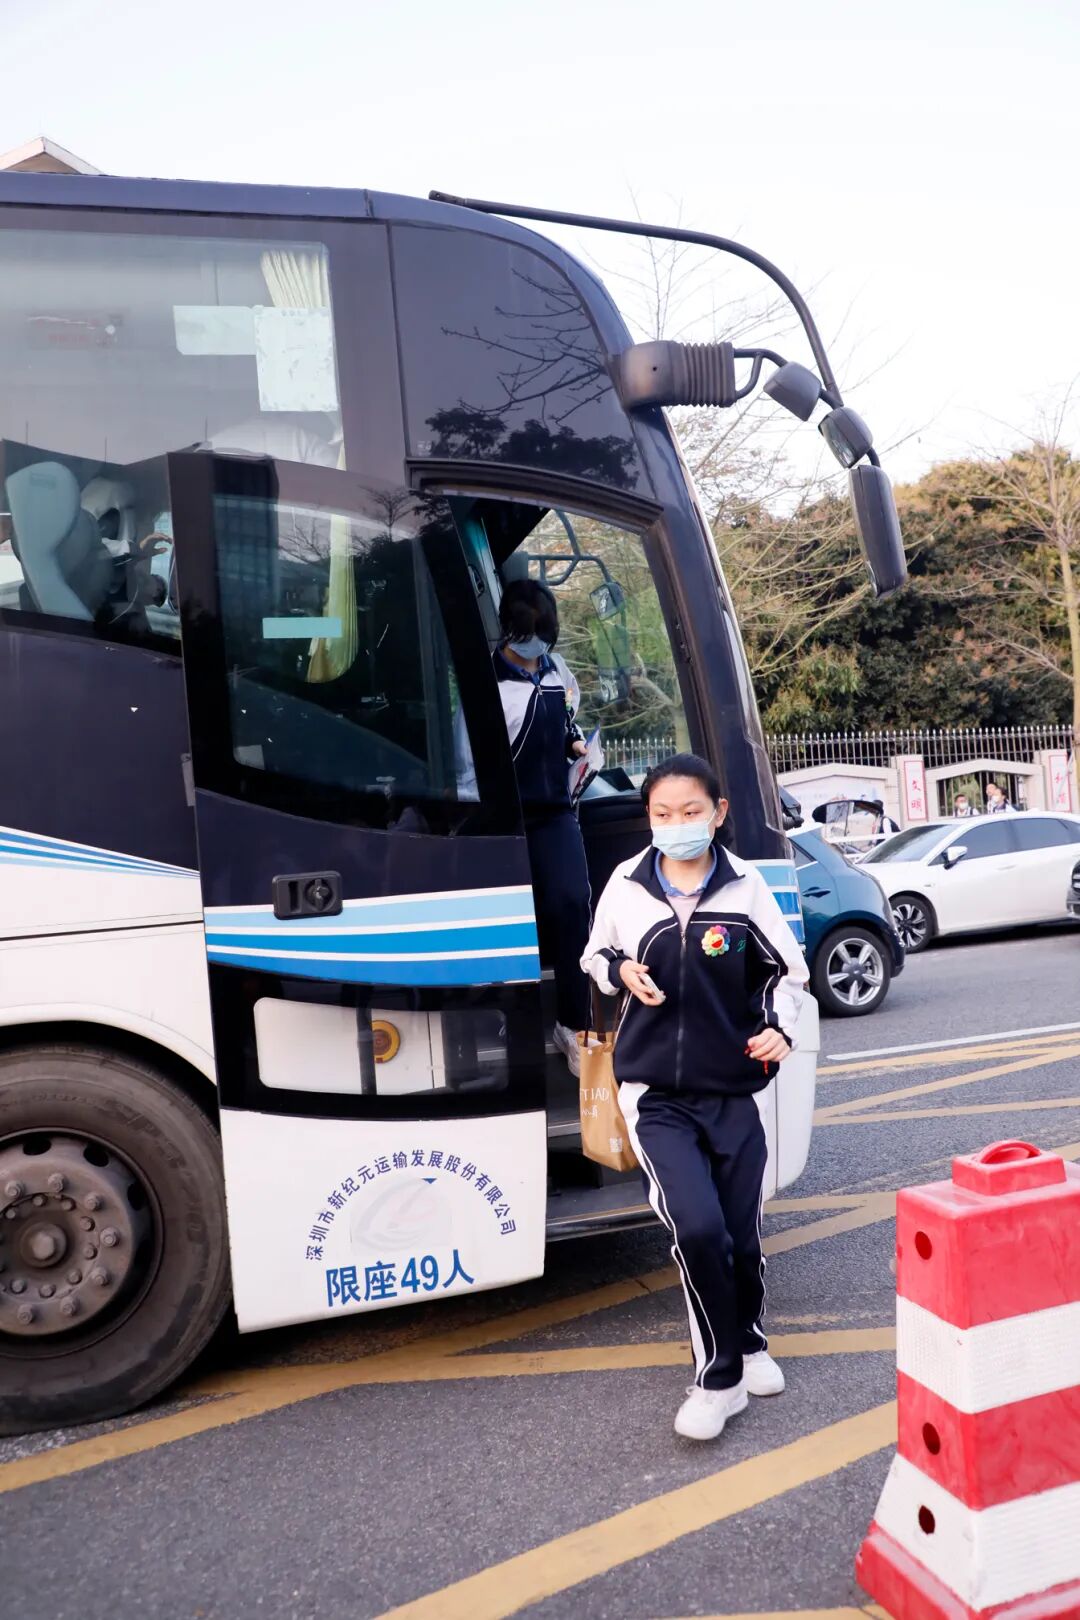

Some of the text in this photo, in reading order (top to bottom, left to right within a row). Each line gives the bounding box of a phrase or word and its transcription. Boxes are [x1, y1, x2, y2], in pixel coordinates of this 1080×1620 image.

[305, 1149, 517, 1261] 深圳市新纪元运输发展股份有限公司
[325, 1249, 475, 1307] 限座49人
